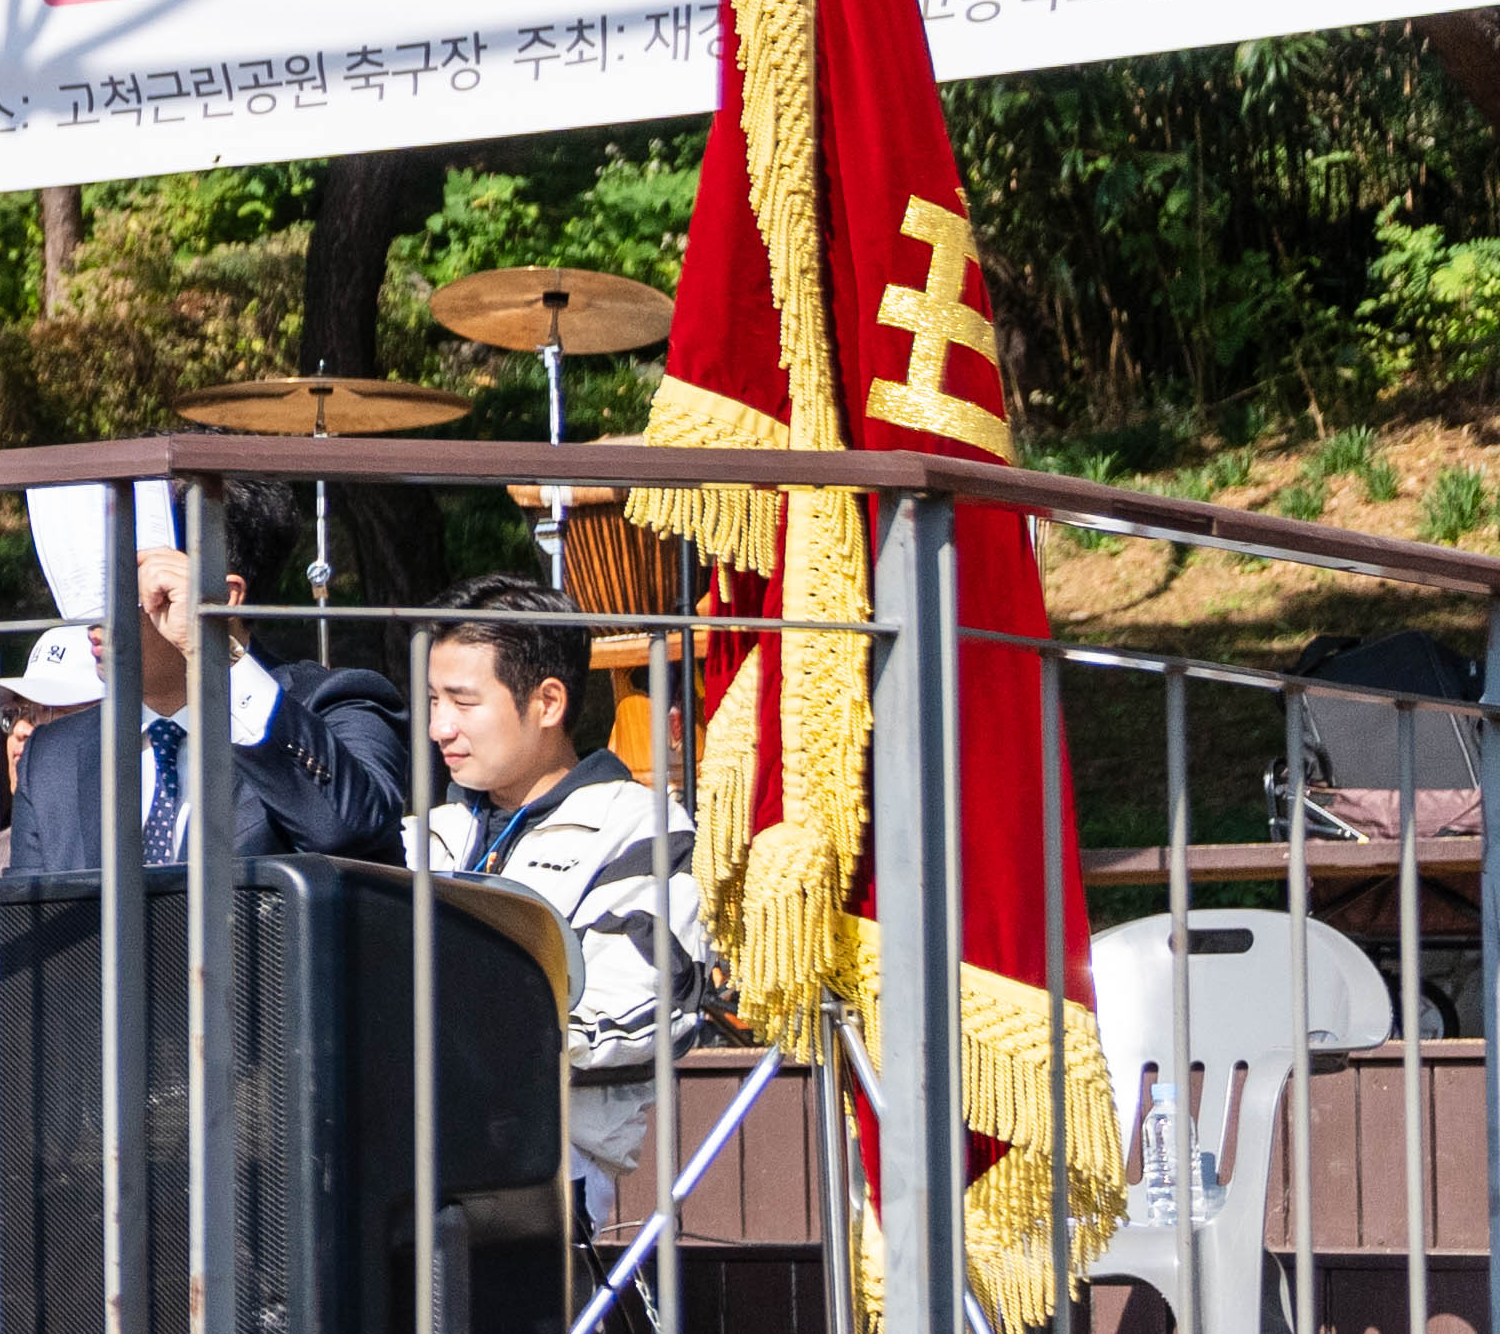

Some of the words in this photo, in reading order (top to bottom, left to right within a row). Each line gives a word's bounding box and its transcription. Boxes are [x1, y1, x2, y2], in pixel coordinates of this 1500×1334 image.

[56, 51, 329, 129] 고척근린공원
[342, 30, 489, 101] 축구장
[513, 15, 626, 81] 주최:
